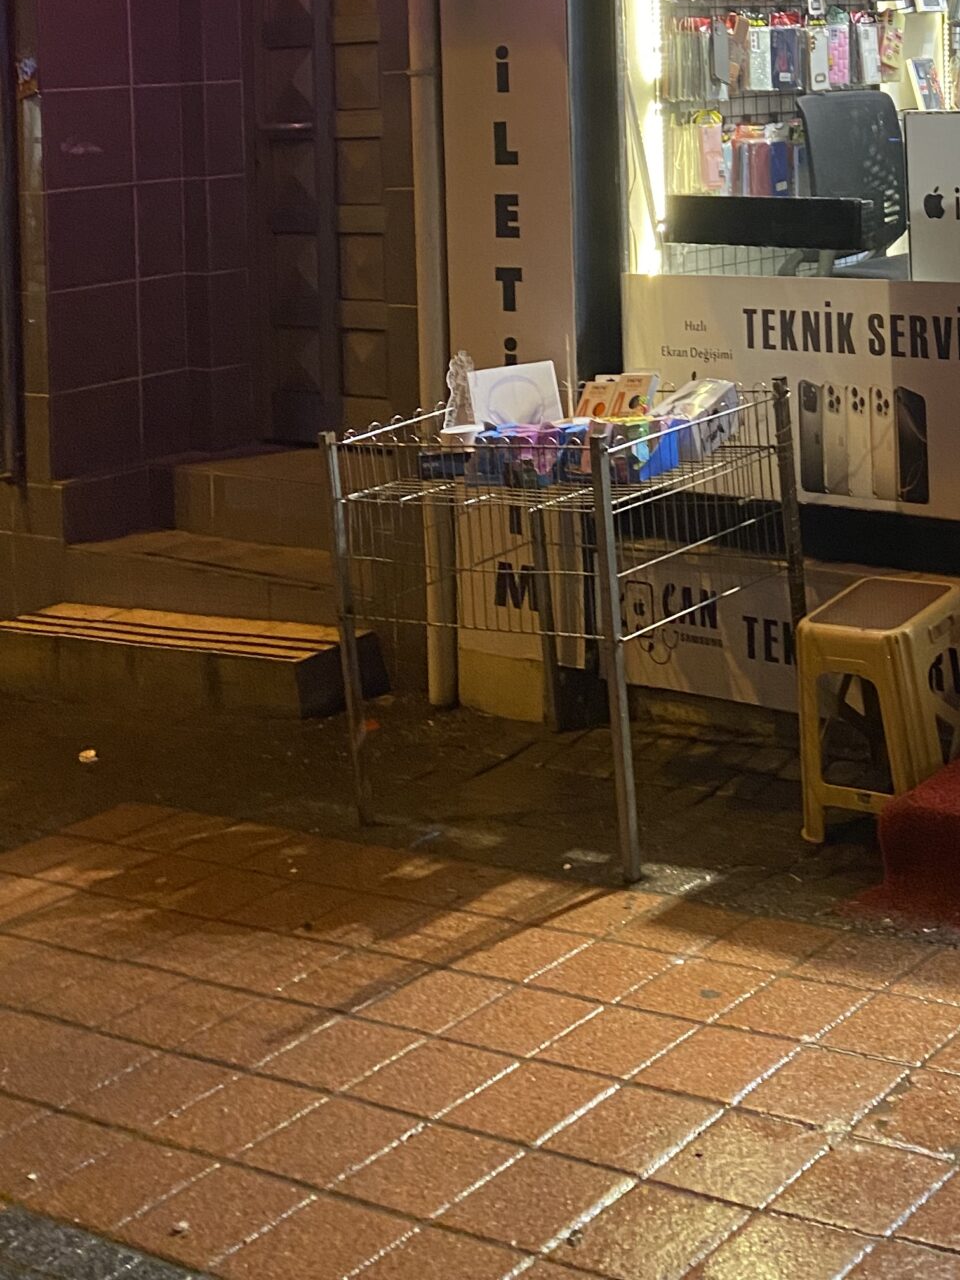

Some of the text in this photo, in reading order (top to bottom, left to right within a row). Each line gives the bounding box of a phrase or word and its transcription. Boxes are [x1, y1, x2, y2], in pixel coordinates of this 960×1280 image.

[684, 320, 707, 332] Hızlı
[742, 301, 856, 354] TEKNİK
[661, 345, 733, 363] Ekran Değişimi
